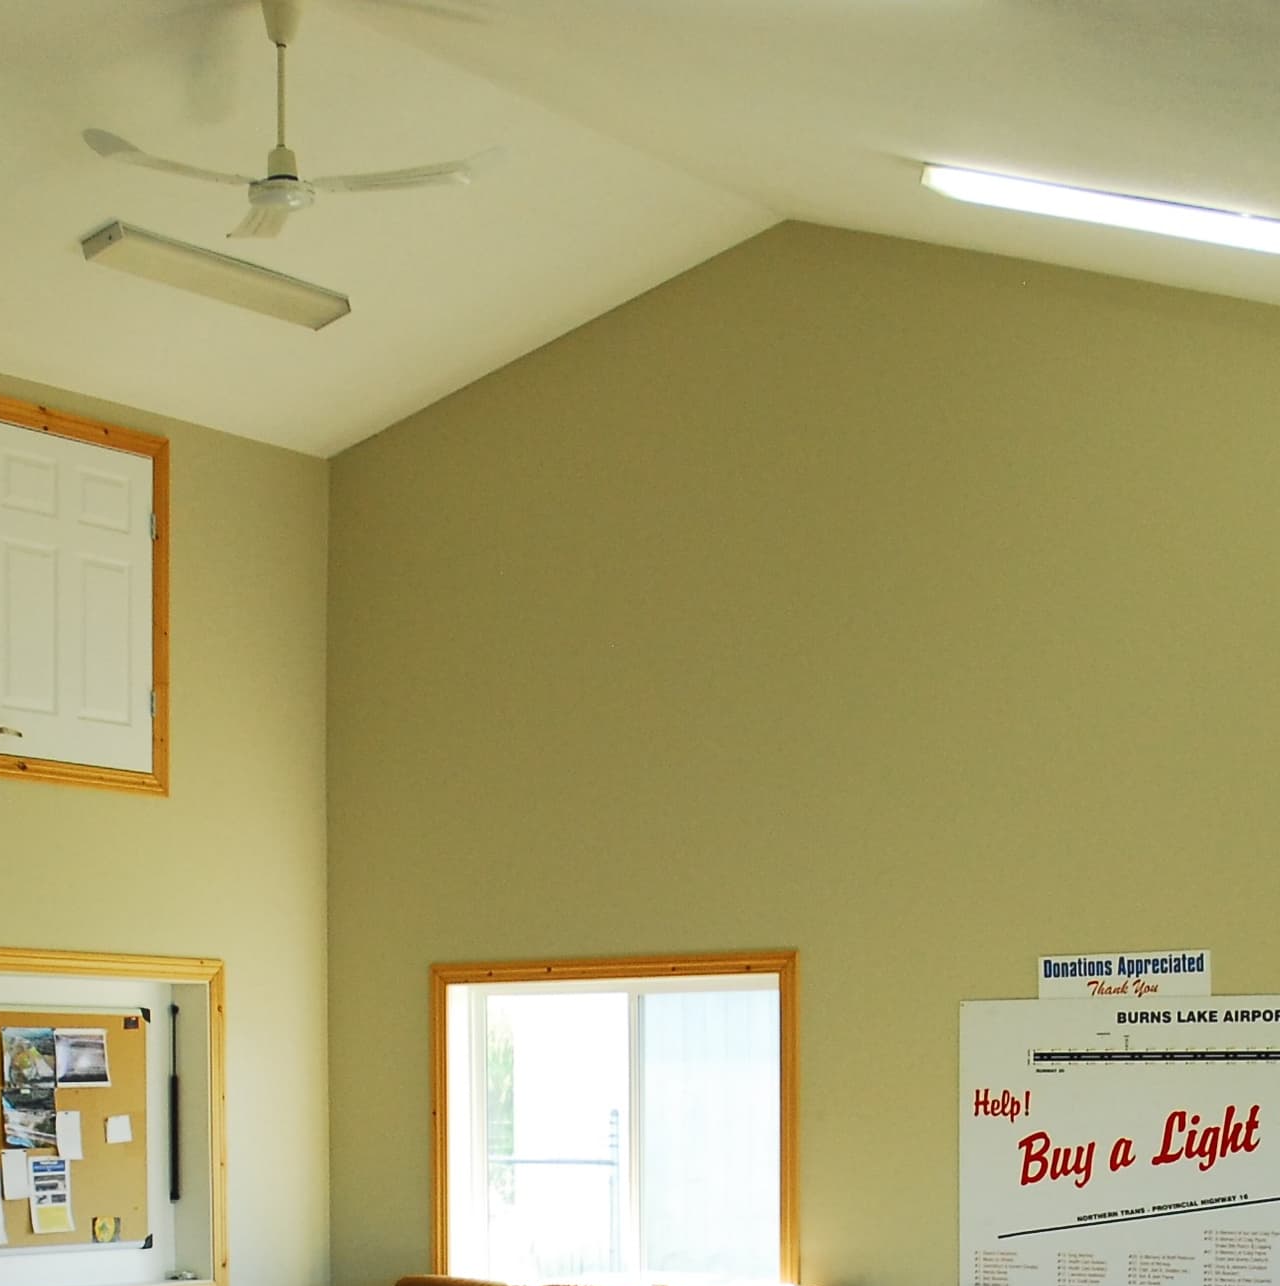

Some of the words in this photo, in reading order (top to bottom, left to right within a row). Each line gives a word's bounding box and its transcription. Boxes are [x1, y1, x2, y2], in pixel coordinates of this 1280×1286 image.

[1043, 957, 1112, 978] Donations
[1117, 953, 1205, 978] Appreciated
[1087, 980, 1128, 996] Thank
[1132, 979, 1159, 997] You
[1117, 1011, 1172, 1024] BURNS
[1177, 1010, 1218, 1023] LAKE
[974, 1088, 1030, 1123] Help!
[1018, 1131, 1095, 1188] Buy
[1109, 1137, 1136, 1172] a
[1151, 1104, 1261, 1172] Light
[1076, 1210, 1118, 1222] NORTHERN
[1120, 1208, 1146, 1216] TRANS
[1152, 1200, 1198, 1212] PROVINCIAL
[1200, 1195, 1236, 1206] HIGHWAY
